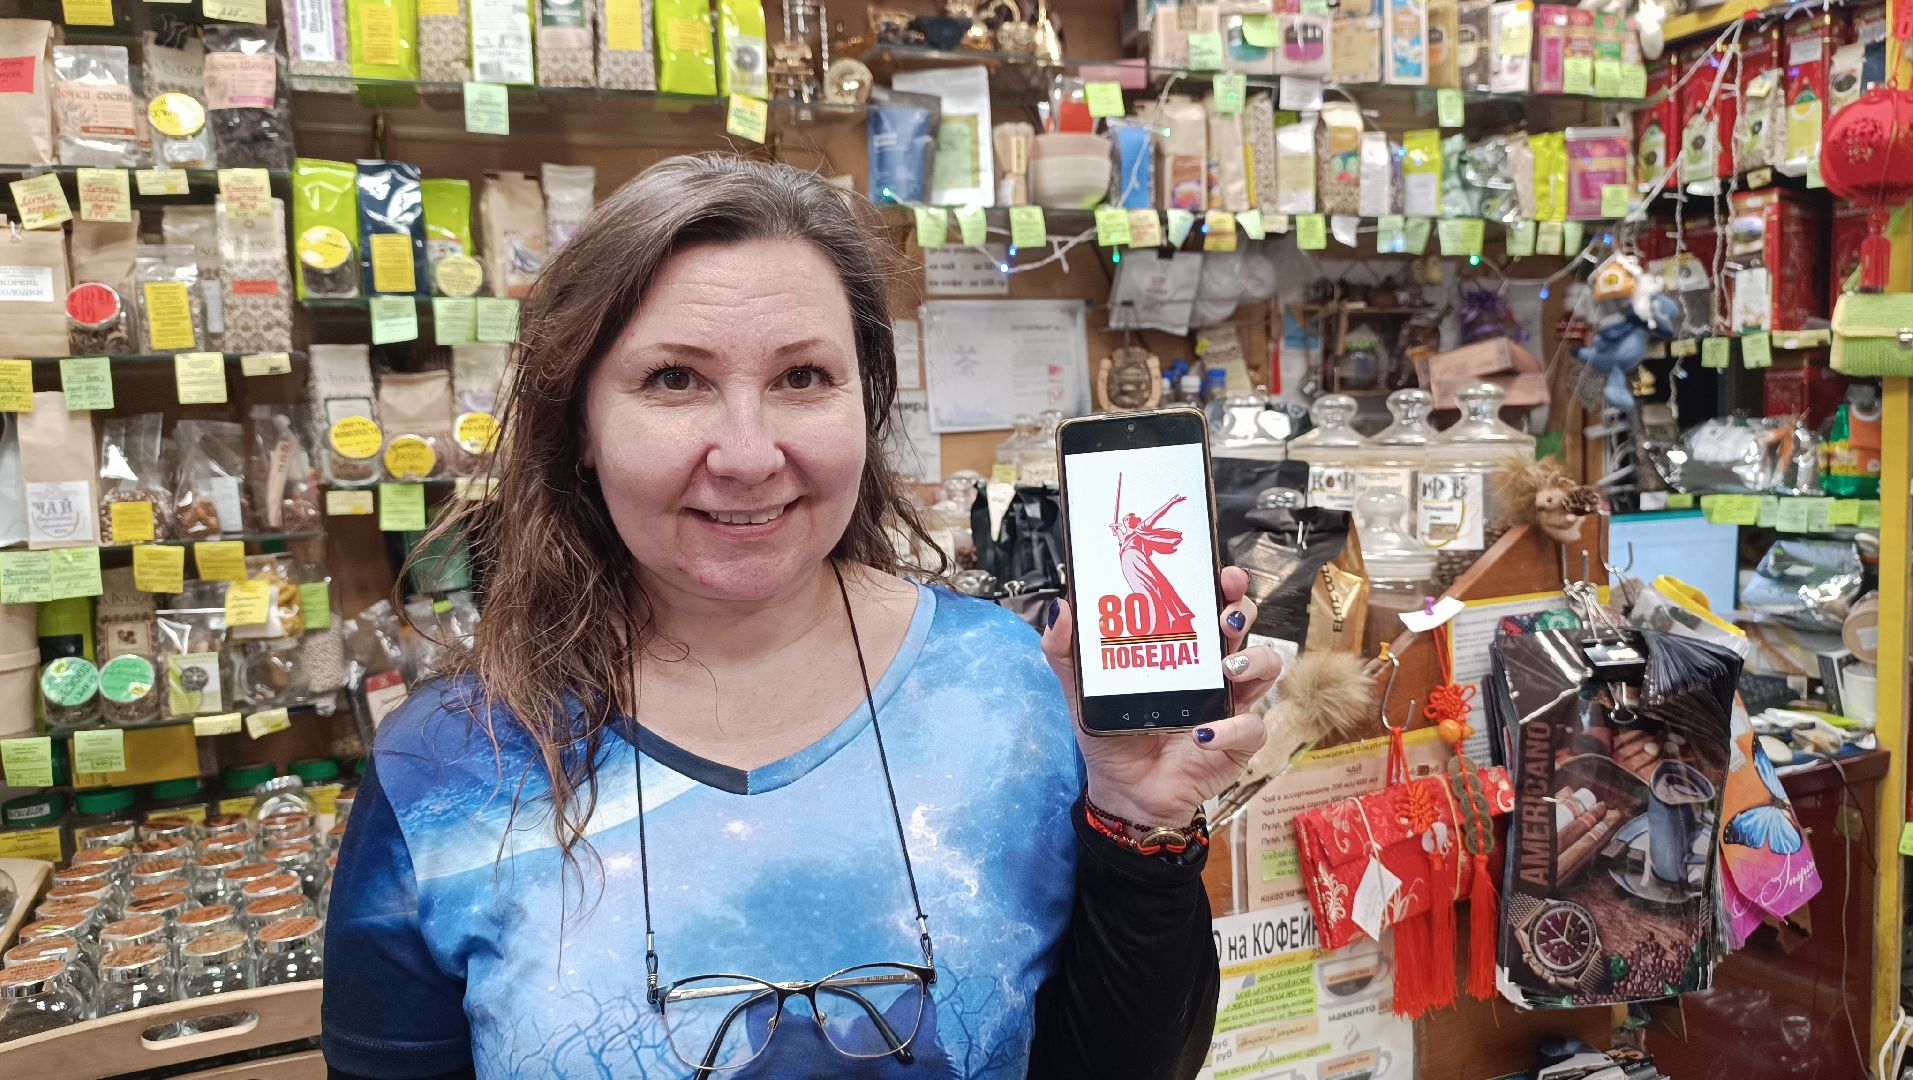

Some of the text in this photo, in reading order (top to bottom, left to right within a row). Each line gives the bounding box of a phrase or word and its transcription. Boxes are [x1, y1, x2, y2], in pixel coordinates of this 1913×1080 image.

[0, 278, 39, 287] КОРЕНЬ
[1098, 592, 1151, 638] 80
[1101, 642, 1200, 670] ПОБЕДА!
[1346, 763, 1362, 774] ЧАЙ
[1262, 795, 1275, 803] Чай
[1332, 782, 1344, 791] 200
[1519, 720, 1551, 886] AMERICANO
[1262, 808, 1275, 816] Чай
[1262, 822, 1282, 831] Пуэр,
[1261, 837, 1281, 846] Пуэр,
[1261, 893, 1283, 902] Какао
[1228, 934, 1247, 961] на
